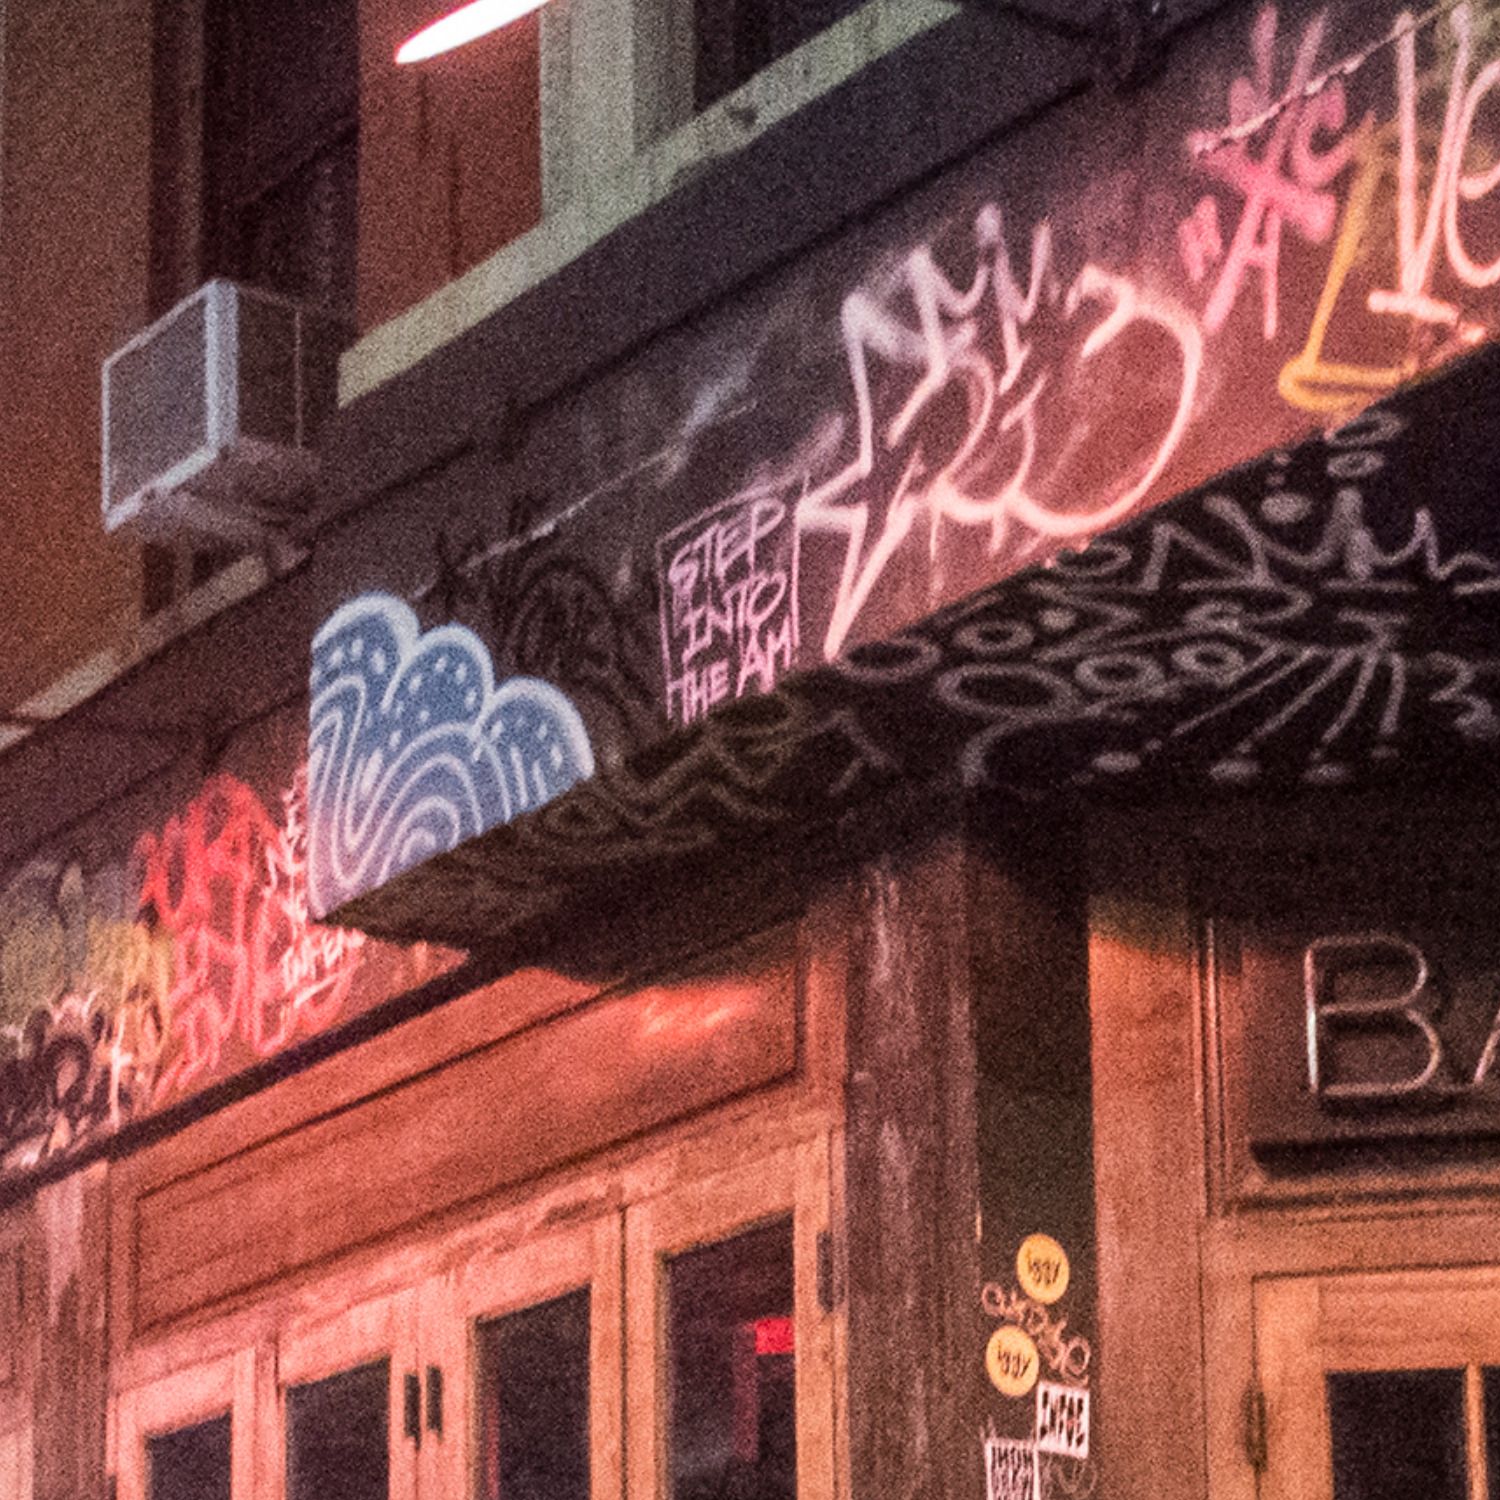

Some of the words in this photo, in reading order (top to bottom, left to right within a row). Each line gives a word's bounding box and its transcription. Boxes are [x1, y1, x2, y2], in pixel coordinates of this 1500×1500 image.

[668, 500, 787, 585] STEP
[680, 570, 789, 662] INTO
[666, 655, 730, 726] THE
